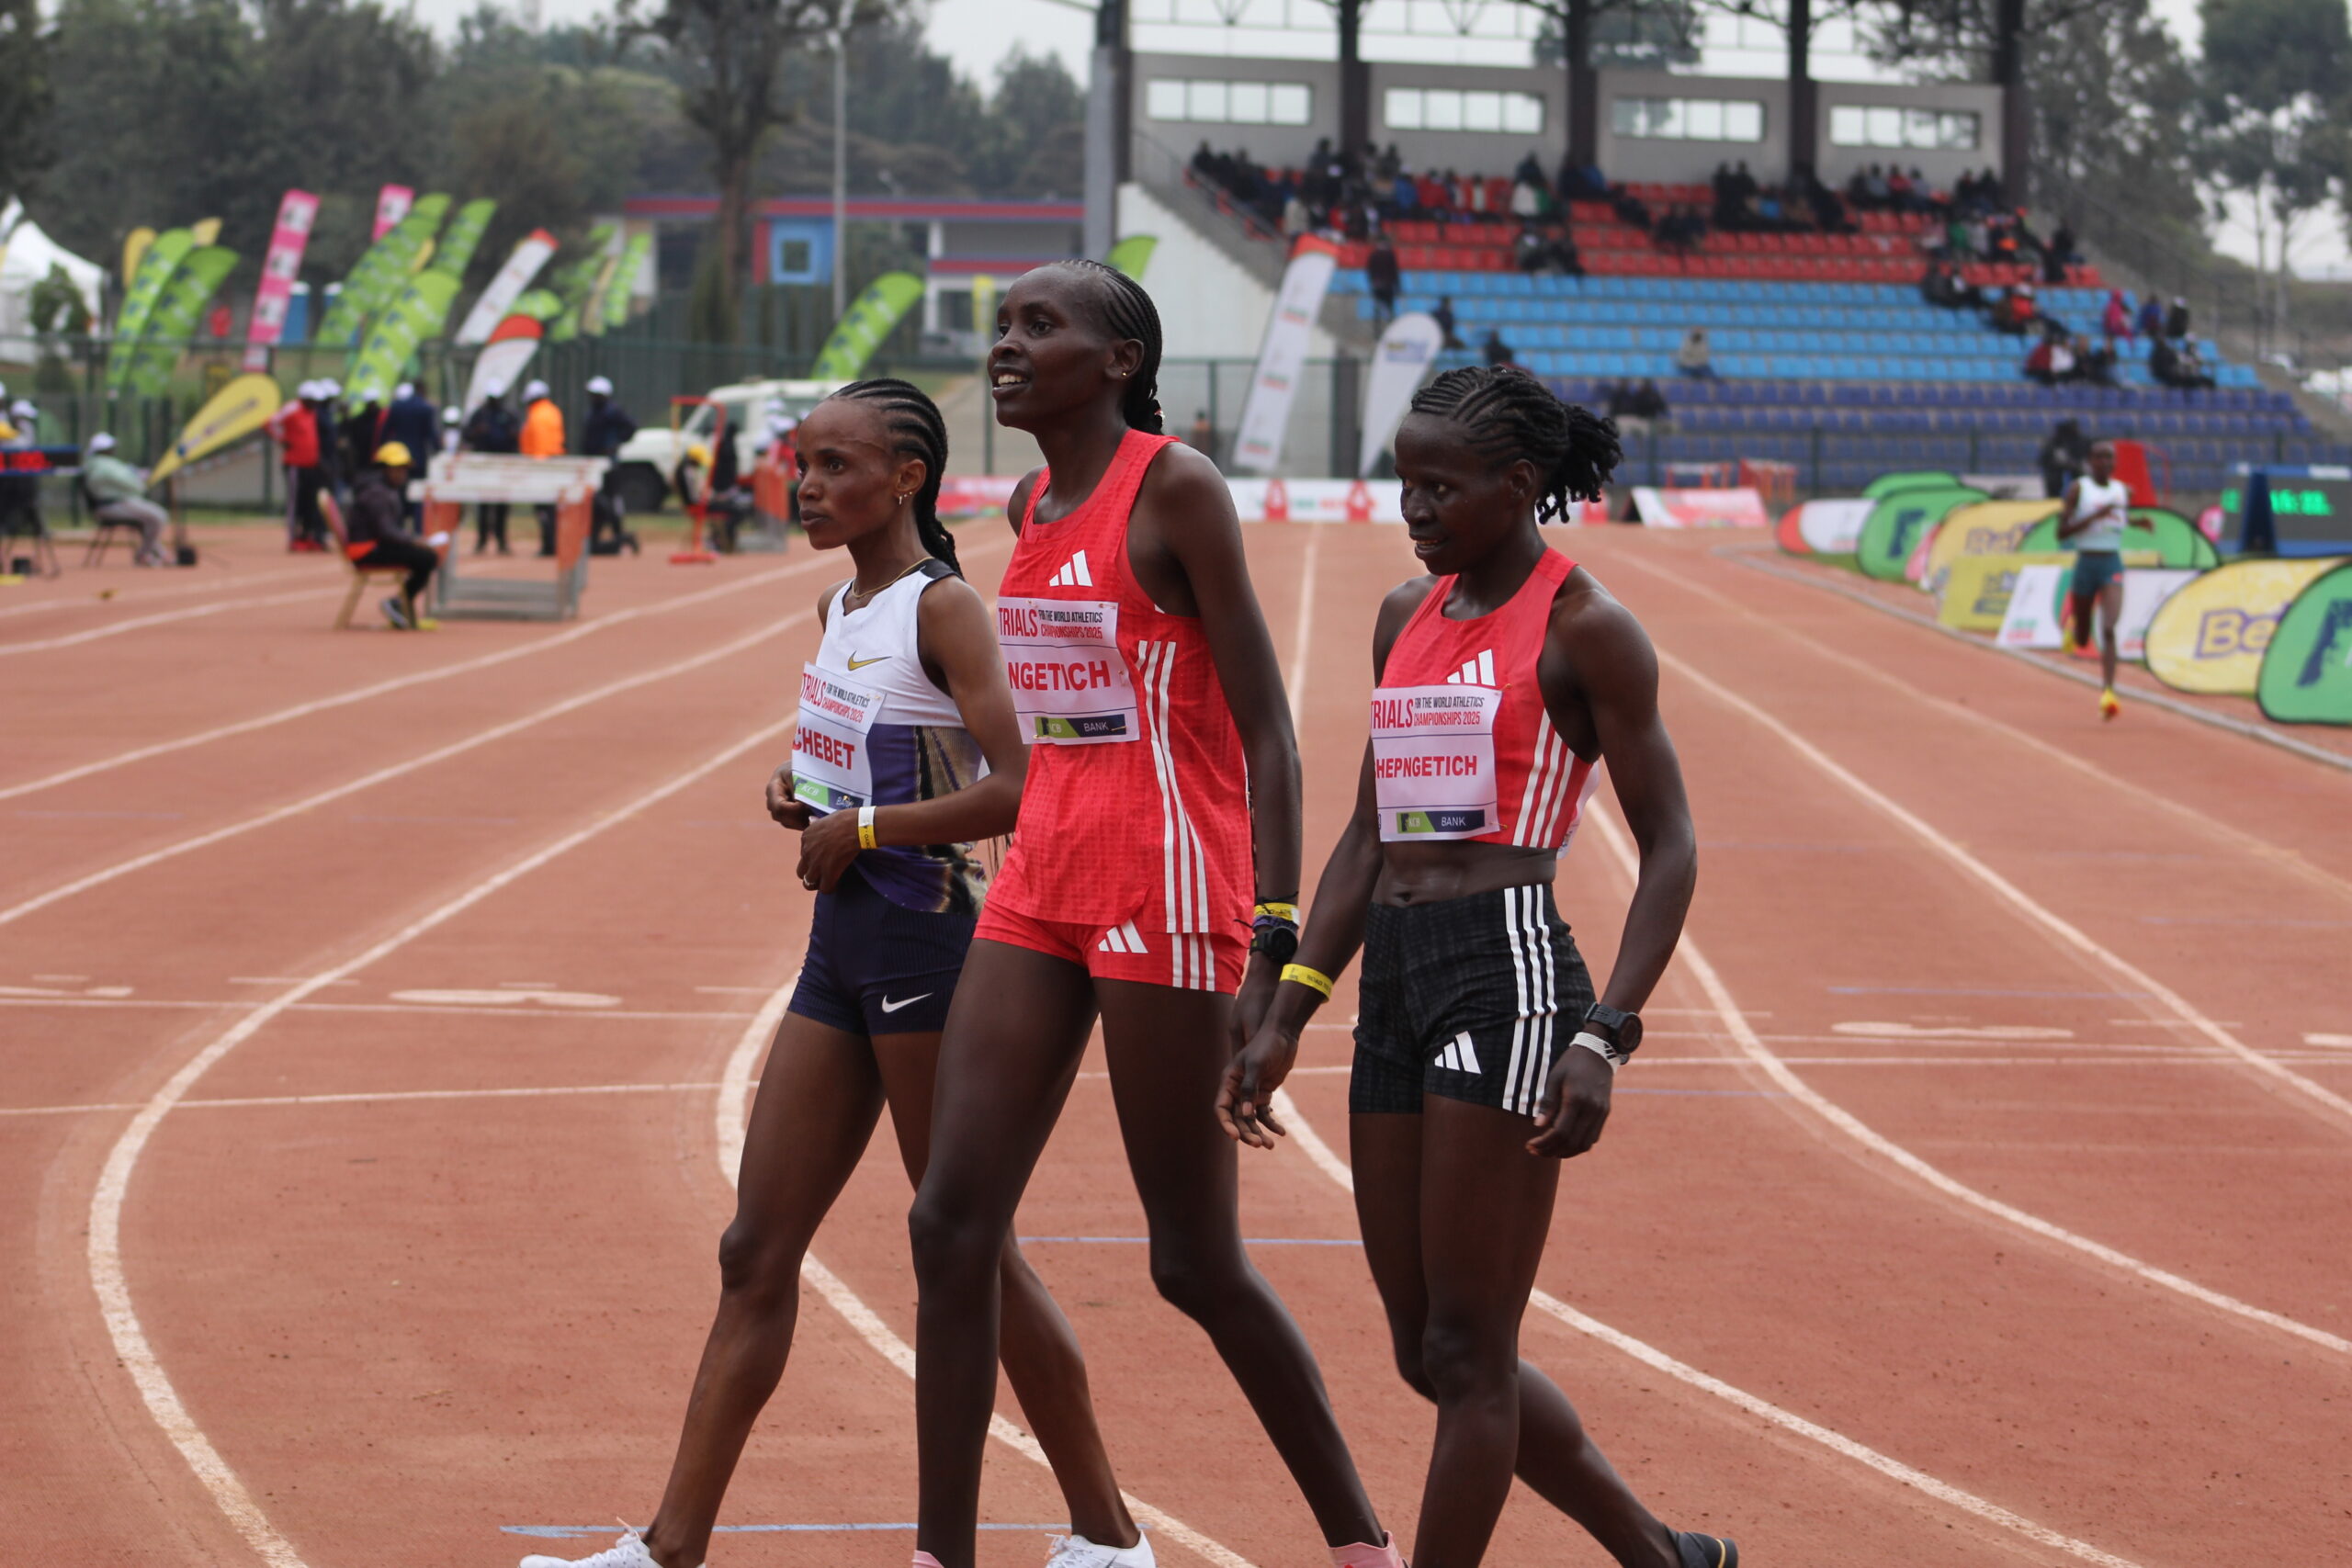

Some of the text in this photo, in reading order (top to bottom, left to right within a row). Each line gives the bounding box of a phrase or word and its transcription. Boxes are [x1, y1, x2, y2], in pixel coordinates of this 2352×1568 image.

[999, 607, 1038, 637] TRIALS
[1054, 611, 1070, 622] WORLD
[1071, 611, 1102, 623] ATHLETICS
[1041, 624, 1102, 639] CHAMPIONSHIPS 2025
[1008, 660, 1111, 691] NGETICH
[800, 672, 827, 706] TRIALS
[838, 687, 848, 700] WORLD
[847, 692, 870, 708] ATHLETICS
[1422, 697, 1431, 708] THE
[1433, 696, 1452, 708] WORLD
[1453, 695, 1485, 708] ATHLETICS
[849, 707, 865, 723] 2025
[1414, 711, 1480, 726] CHAMPIONSHIPS 2025
[1084, 722, 1109, 732] BANK
[1375, 755, 1477, 779] HEPNGETICH
[801, 784, 820, 796] KCB
[1442, 817, 1466, 827] BANK
